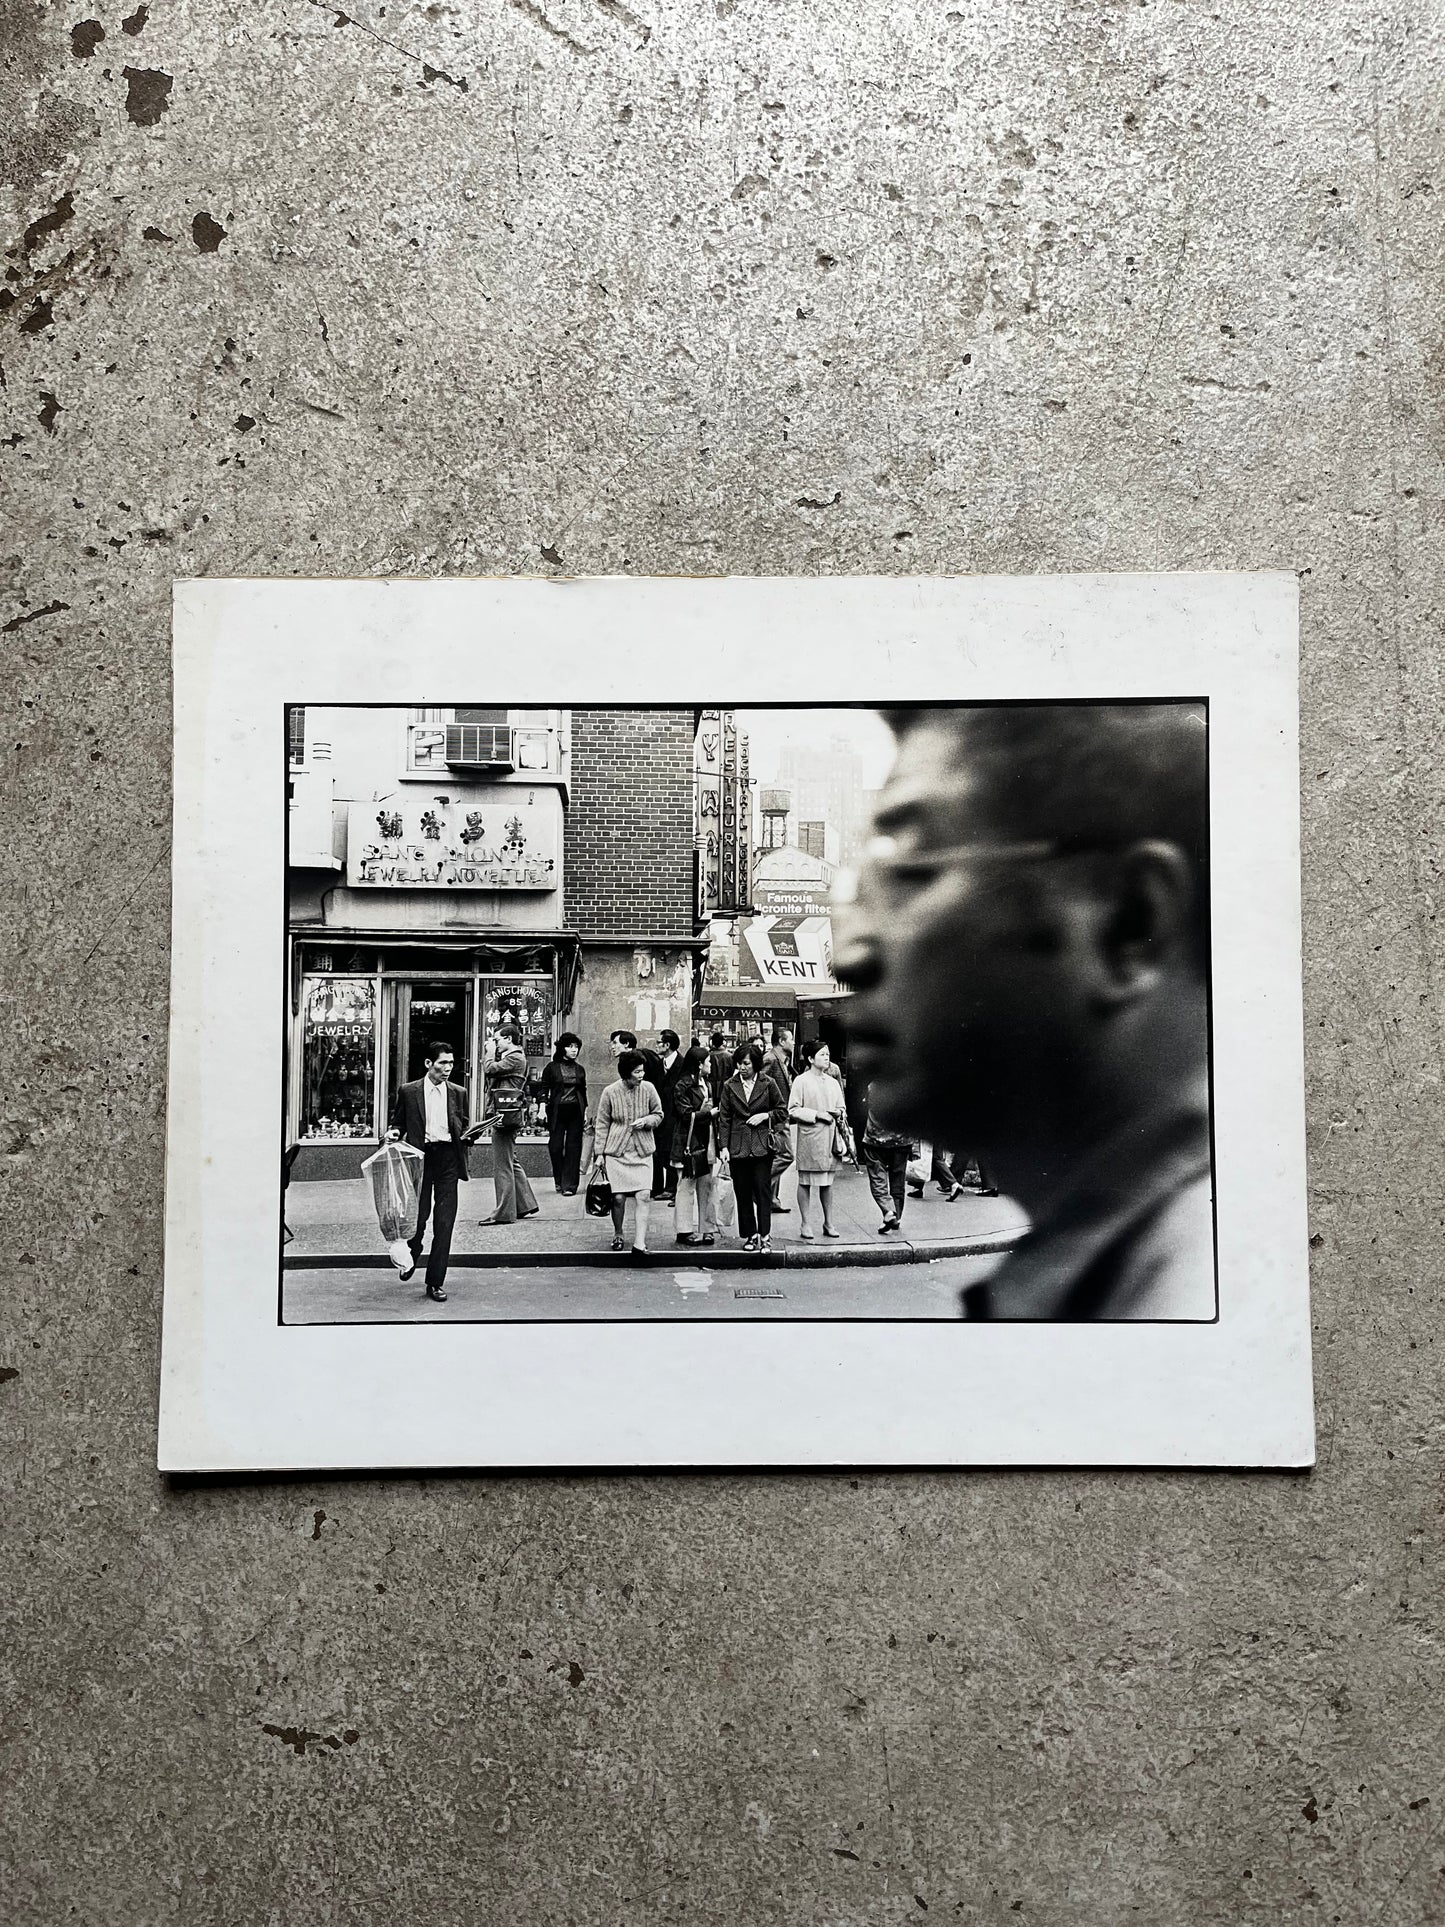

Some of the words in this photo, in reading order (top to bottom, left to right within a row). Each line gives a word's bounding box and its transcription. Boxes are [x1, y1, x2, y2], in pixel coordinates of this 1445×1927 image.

[724, 712, 736, 905] RESTAURANT
[357, 861, 443, 883] JEWELRY
[767, 892, 813, 903] Famous
[763, 959, 817, 978] KENT
[485, 986, 511, 1004] SANG
[511, 986, 542, 1000] CHONG
[509, 998, 522, 1006] 85
[701, 1007, 729, 1017] TOY
[740, 1009, 773, 1018] WAN
[308, 1025, 372, 1036] JEWELRY
